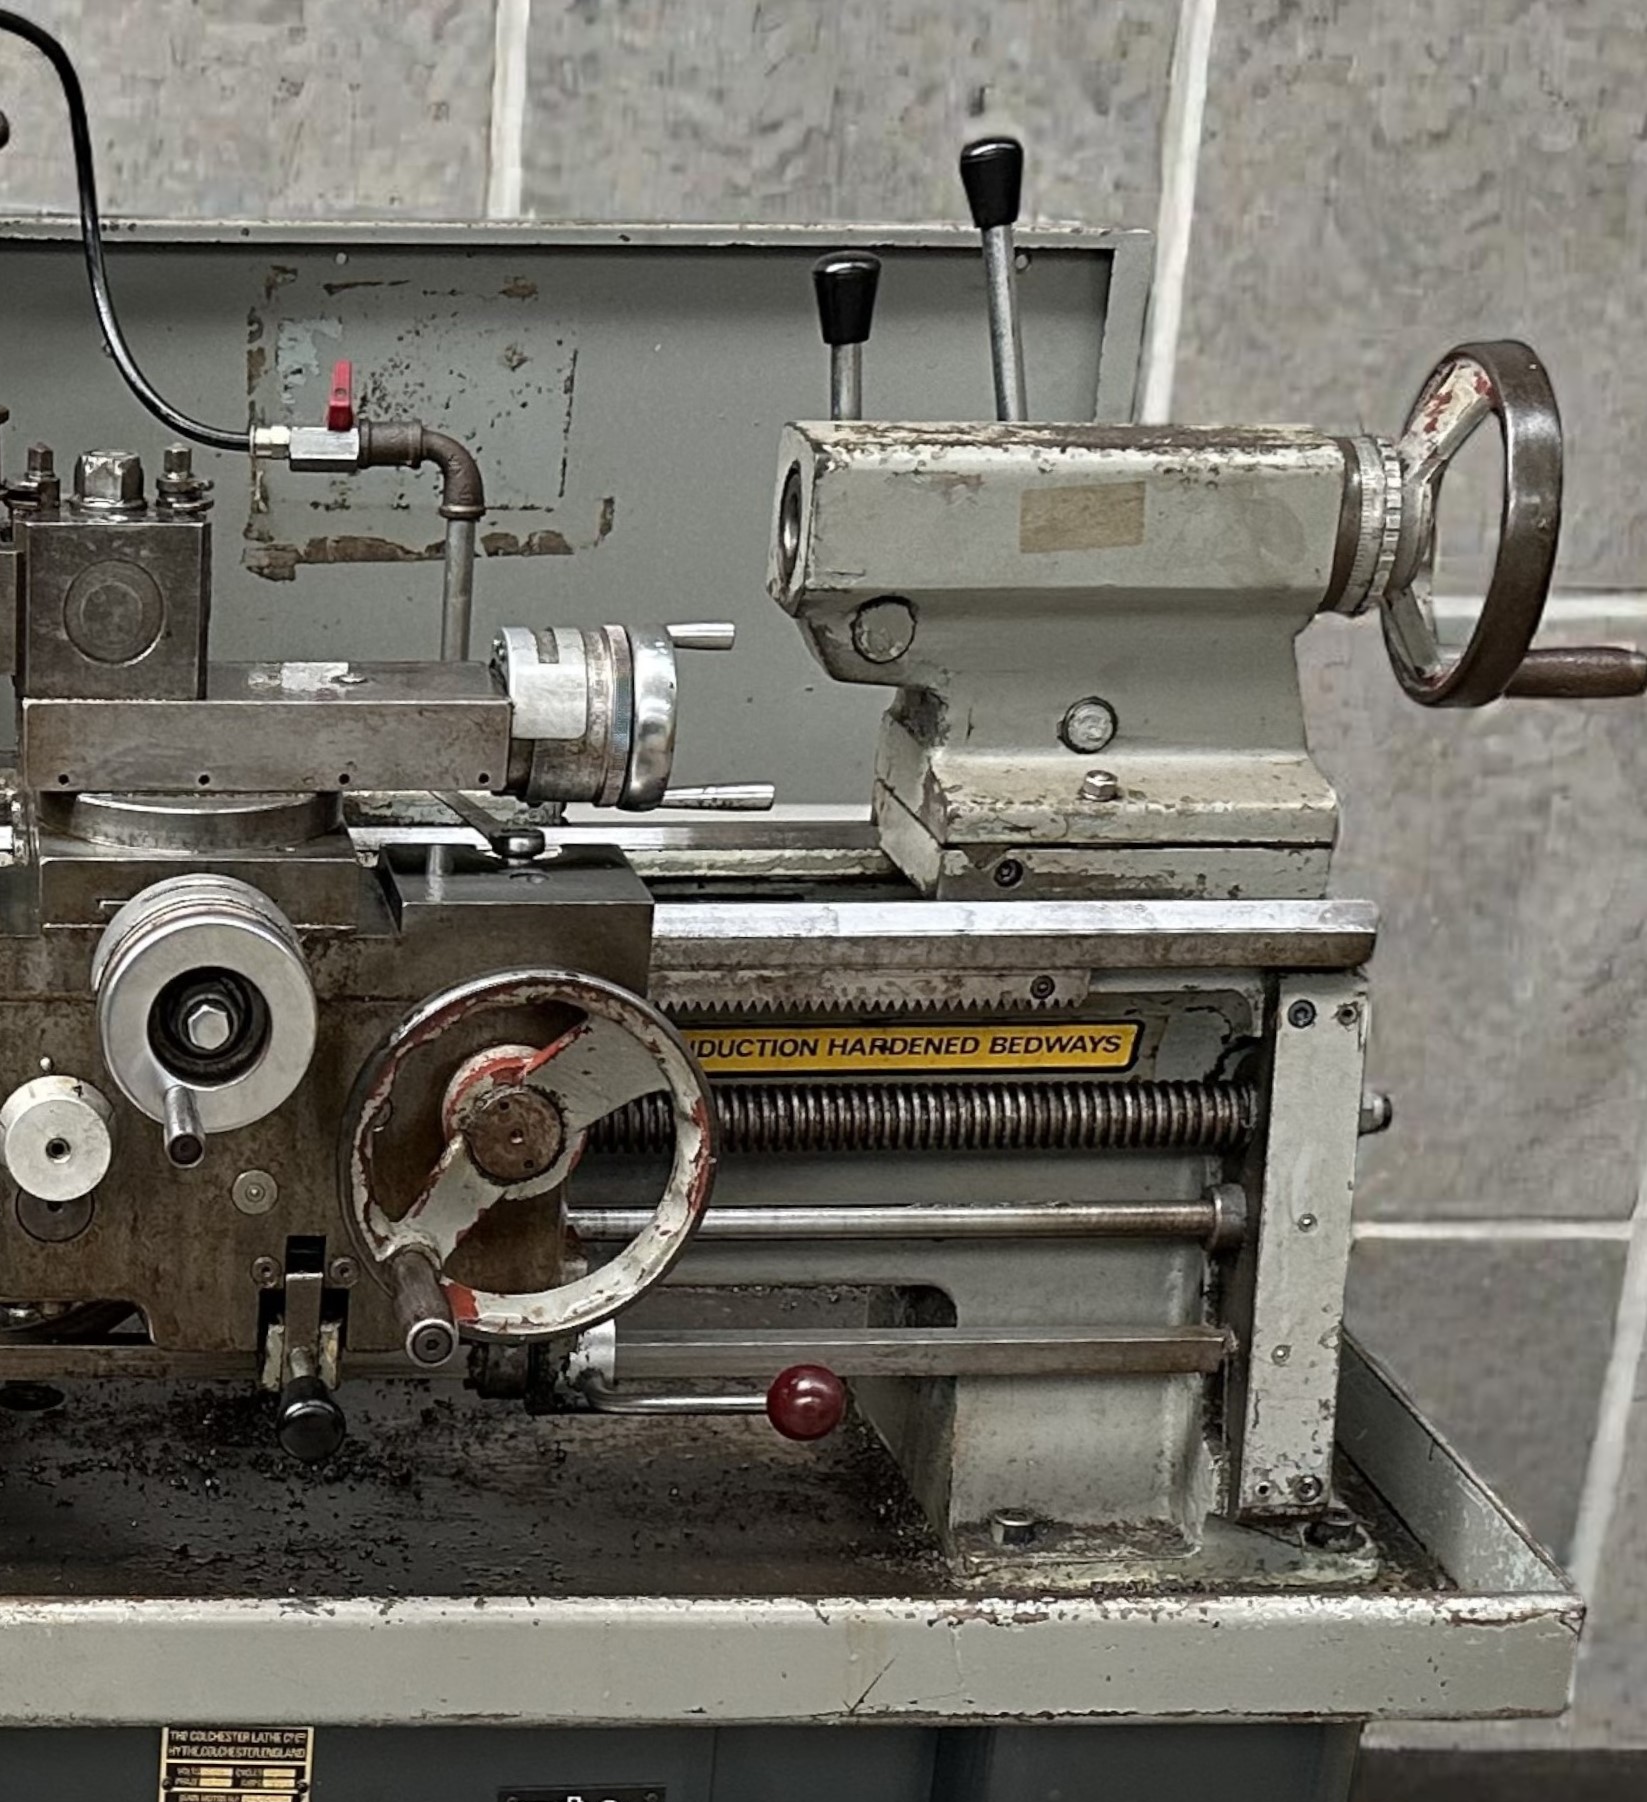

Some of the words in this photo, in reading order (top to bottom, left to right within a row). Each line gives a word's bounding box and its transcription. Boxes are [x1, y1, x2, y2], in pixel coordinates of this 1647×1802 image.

[690, 1038, 819, 1058] DUCTION
[827, 1036, 980, 1056] HARDENED
[988, 1035, 1122, 1055] BEDWAYS
[190, 1731, 250, 1743] COLCHESTER
[252, 1732, 282, 1743] LATHE
